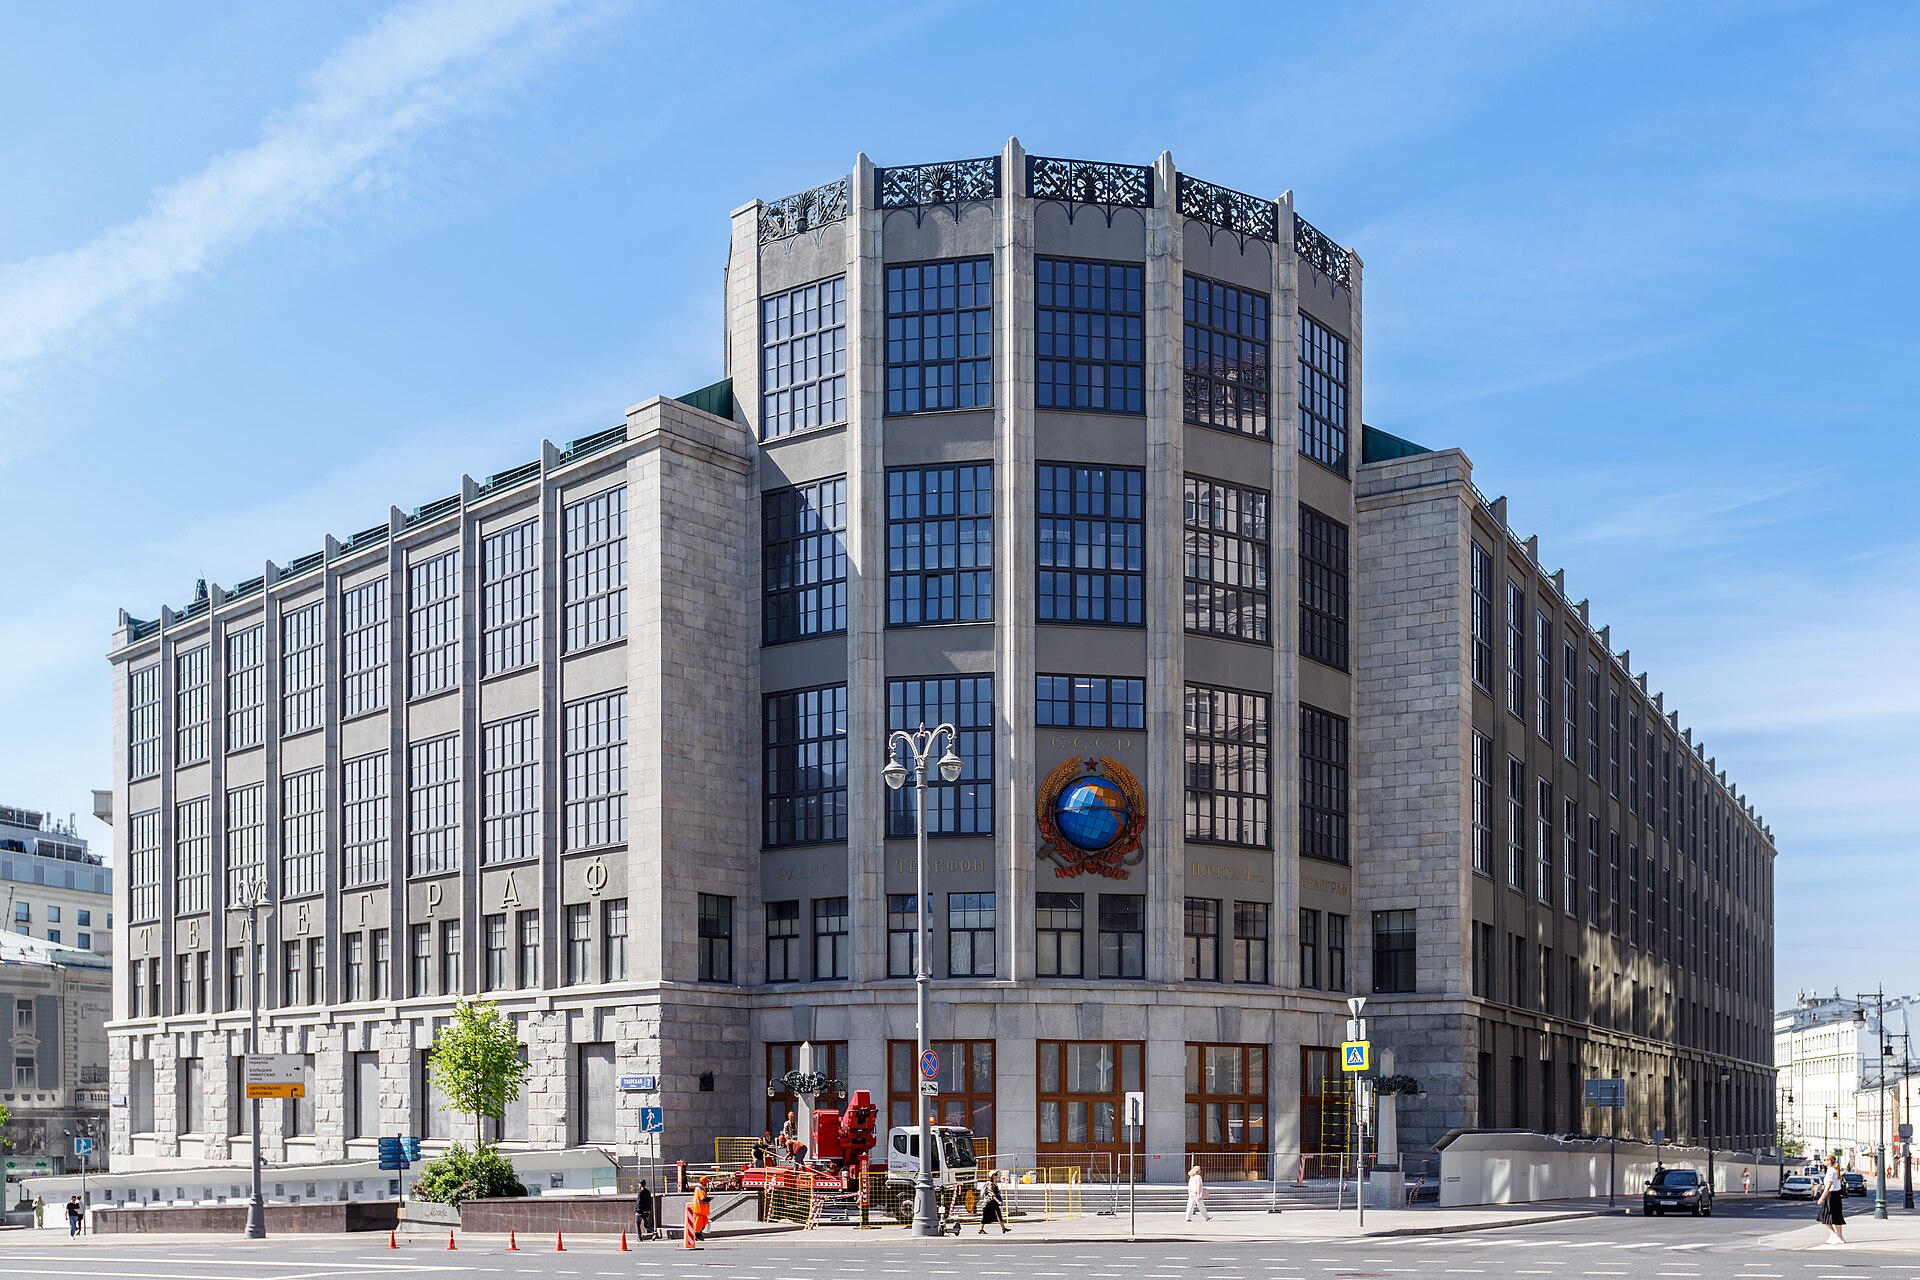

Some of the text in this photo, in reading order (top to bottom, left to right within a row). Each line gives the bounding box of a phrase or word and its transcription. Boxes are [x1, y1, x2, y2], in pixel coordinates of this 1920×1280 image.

[779, 863, 831, 880] РАДИО
[1191, 863, 1240, 881] ПОЧТА
[1301, 873, 1348, 897] ТЕЛЕГРАФ
[646, 1078, 651, 1087] 7
